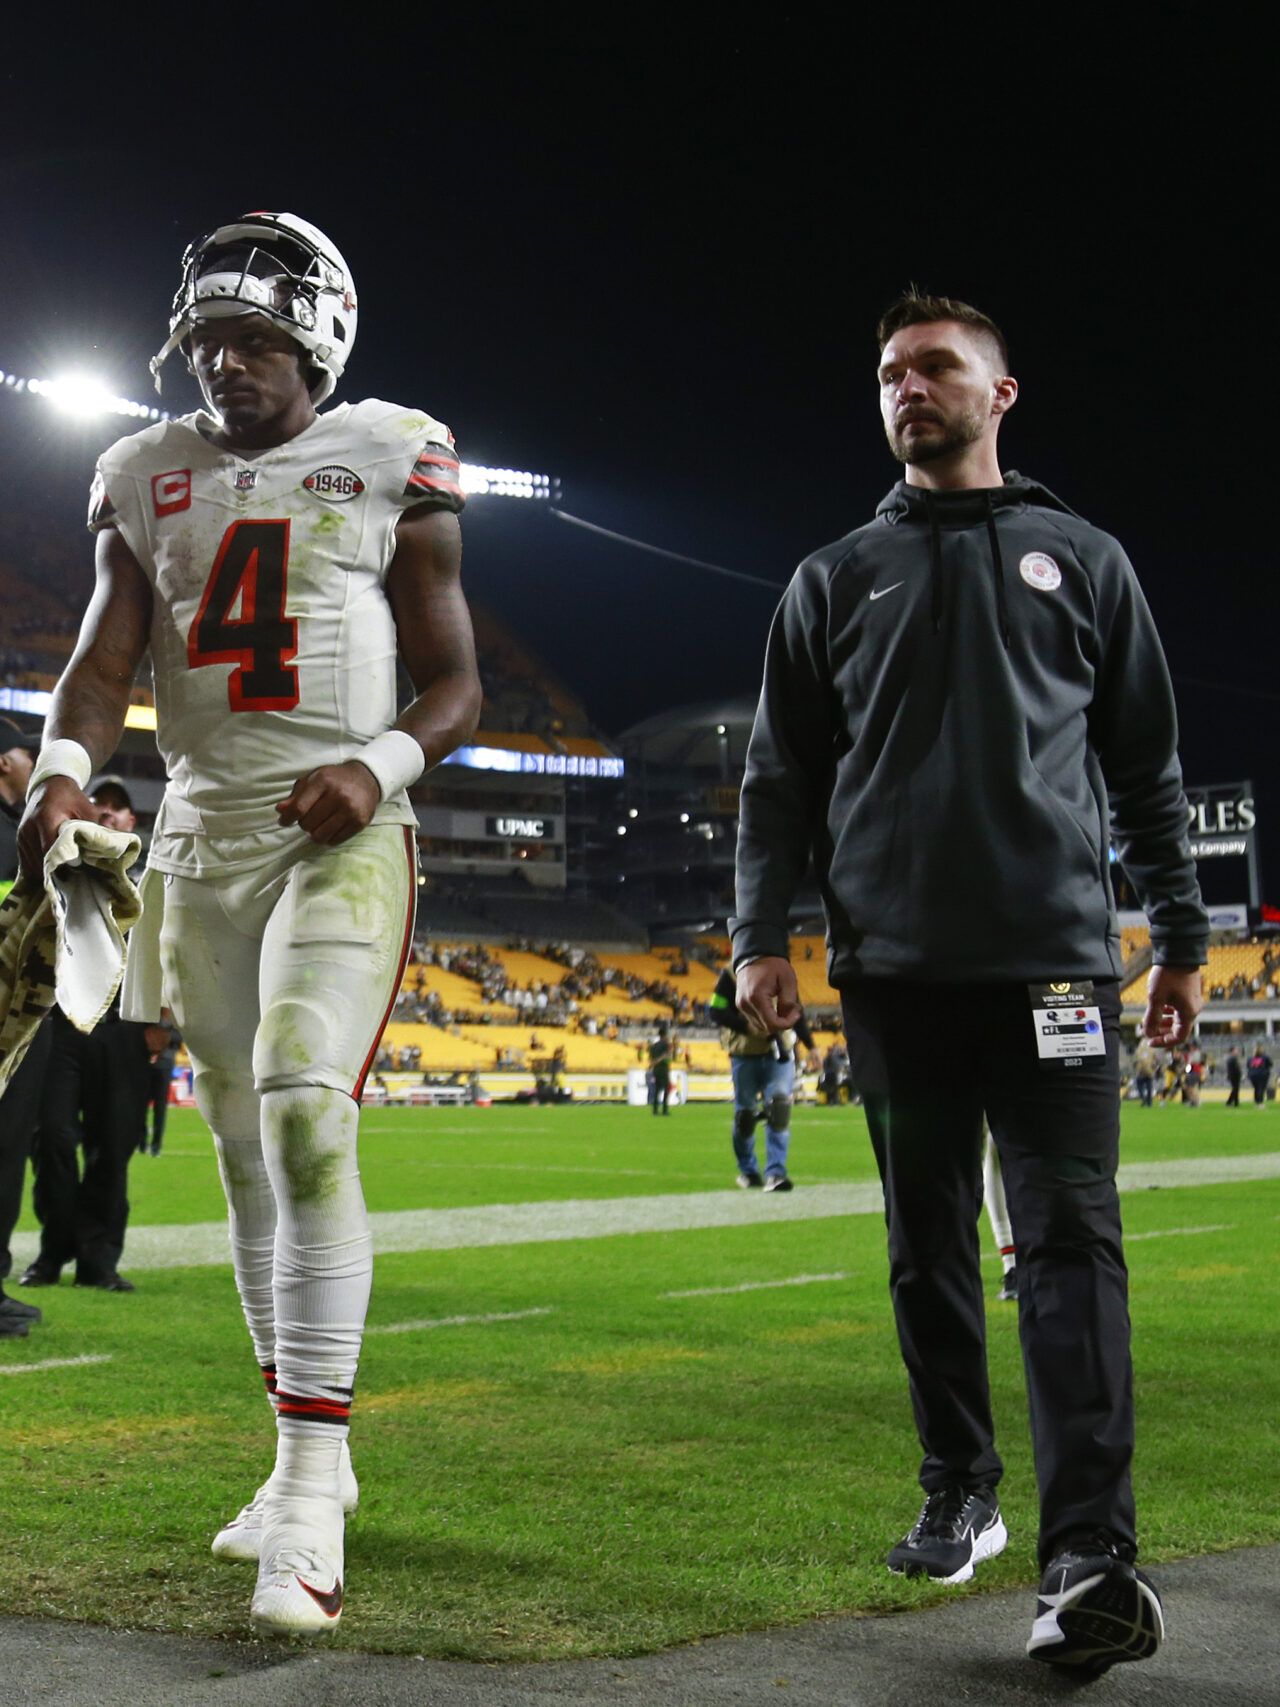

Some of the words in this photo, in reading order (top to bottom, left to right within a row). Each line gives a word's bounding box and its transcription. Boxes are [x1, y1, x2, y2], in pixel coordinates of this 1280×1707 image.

[155, 472, 190, 506] C
[314, 473, 353, 495] 1946
[187, 518, 300, 712] 4
[496, 818, 544, 838] UPMC
[1199, 840, 1247, 857] Company
